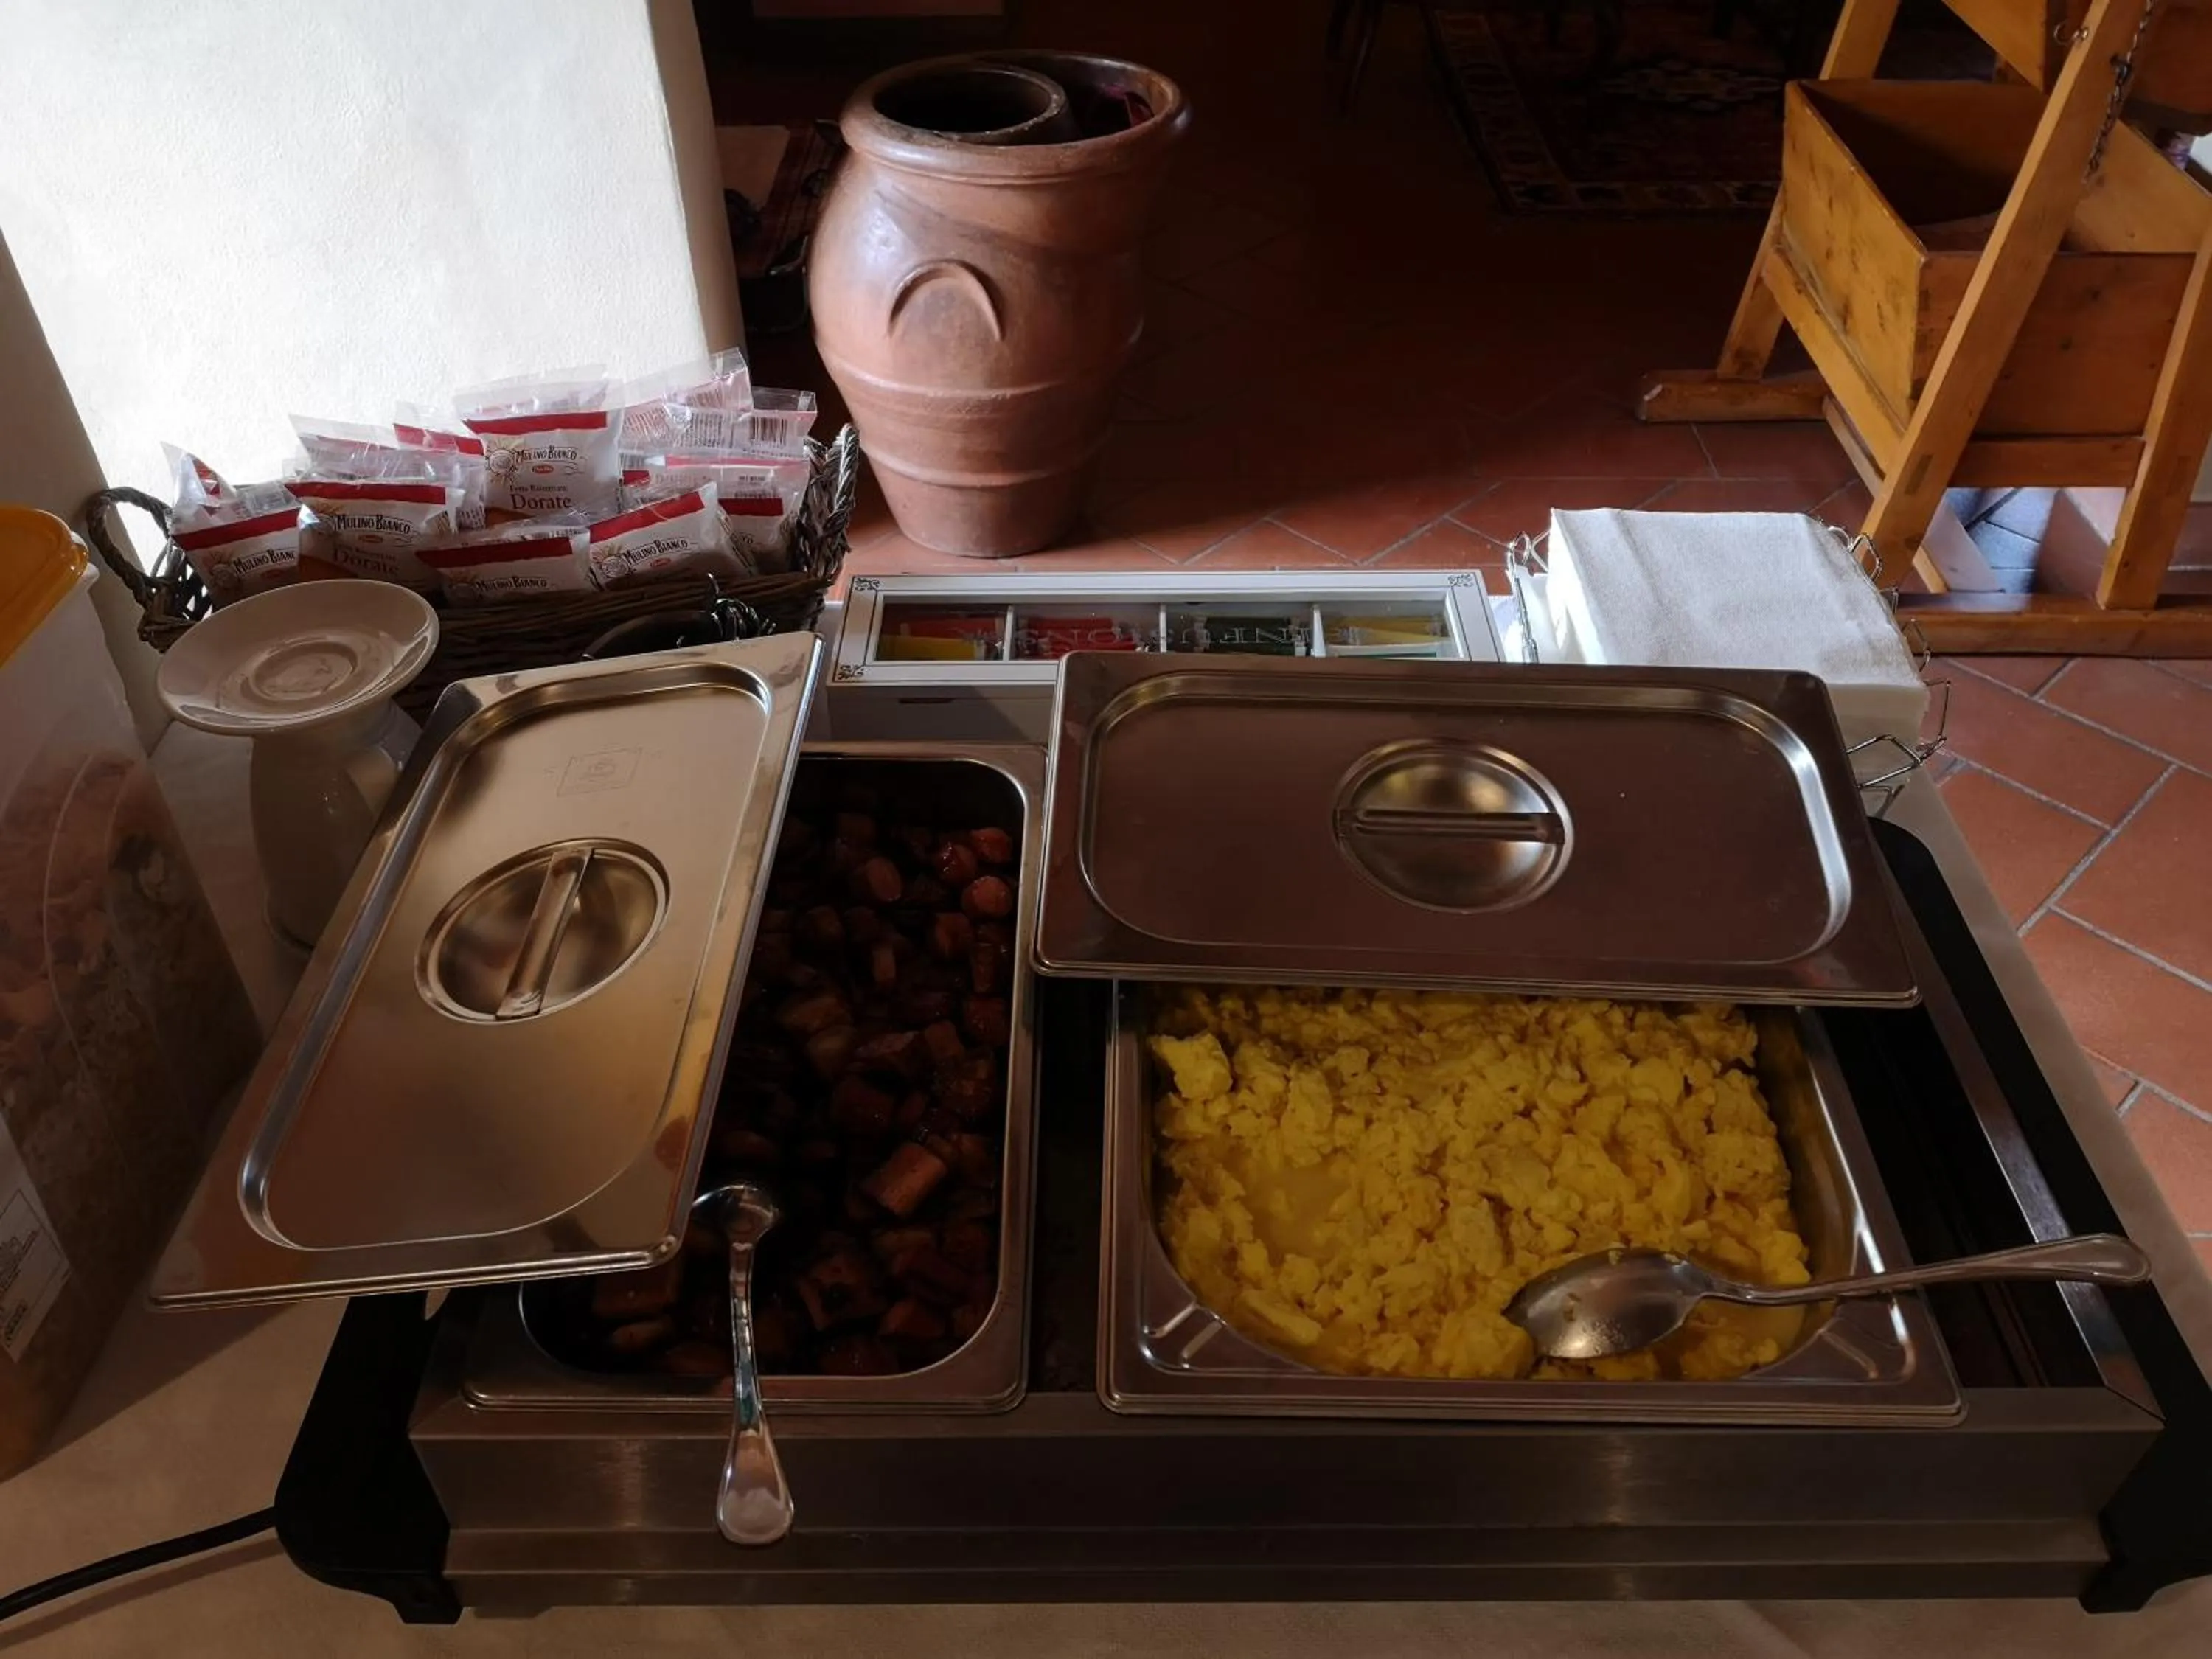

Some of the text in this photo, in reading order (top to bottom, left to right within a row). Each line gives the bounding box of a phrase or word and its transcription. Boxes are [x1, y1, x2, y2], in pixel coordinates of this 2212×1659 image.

[515, 445, 577, 465] MULINO BIANCO
[510, 493, 573, 509] Dorate
[336, 514, 411, 535] MULINO BIANCO
[233, 557, 269, 574] MULINO
[266, 548, 295, 564] BIANC
[333, 547, 400, 574] Dorate
[623, 549, 657, 566] MULINO
[653, 538, 688, 554] BIANCO
[512, 575, 547, 588] BIANCO
